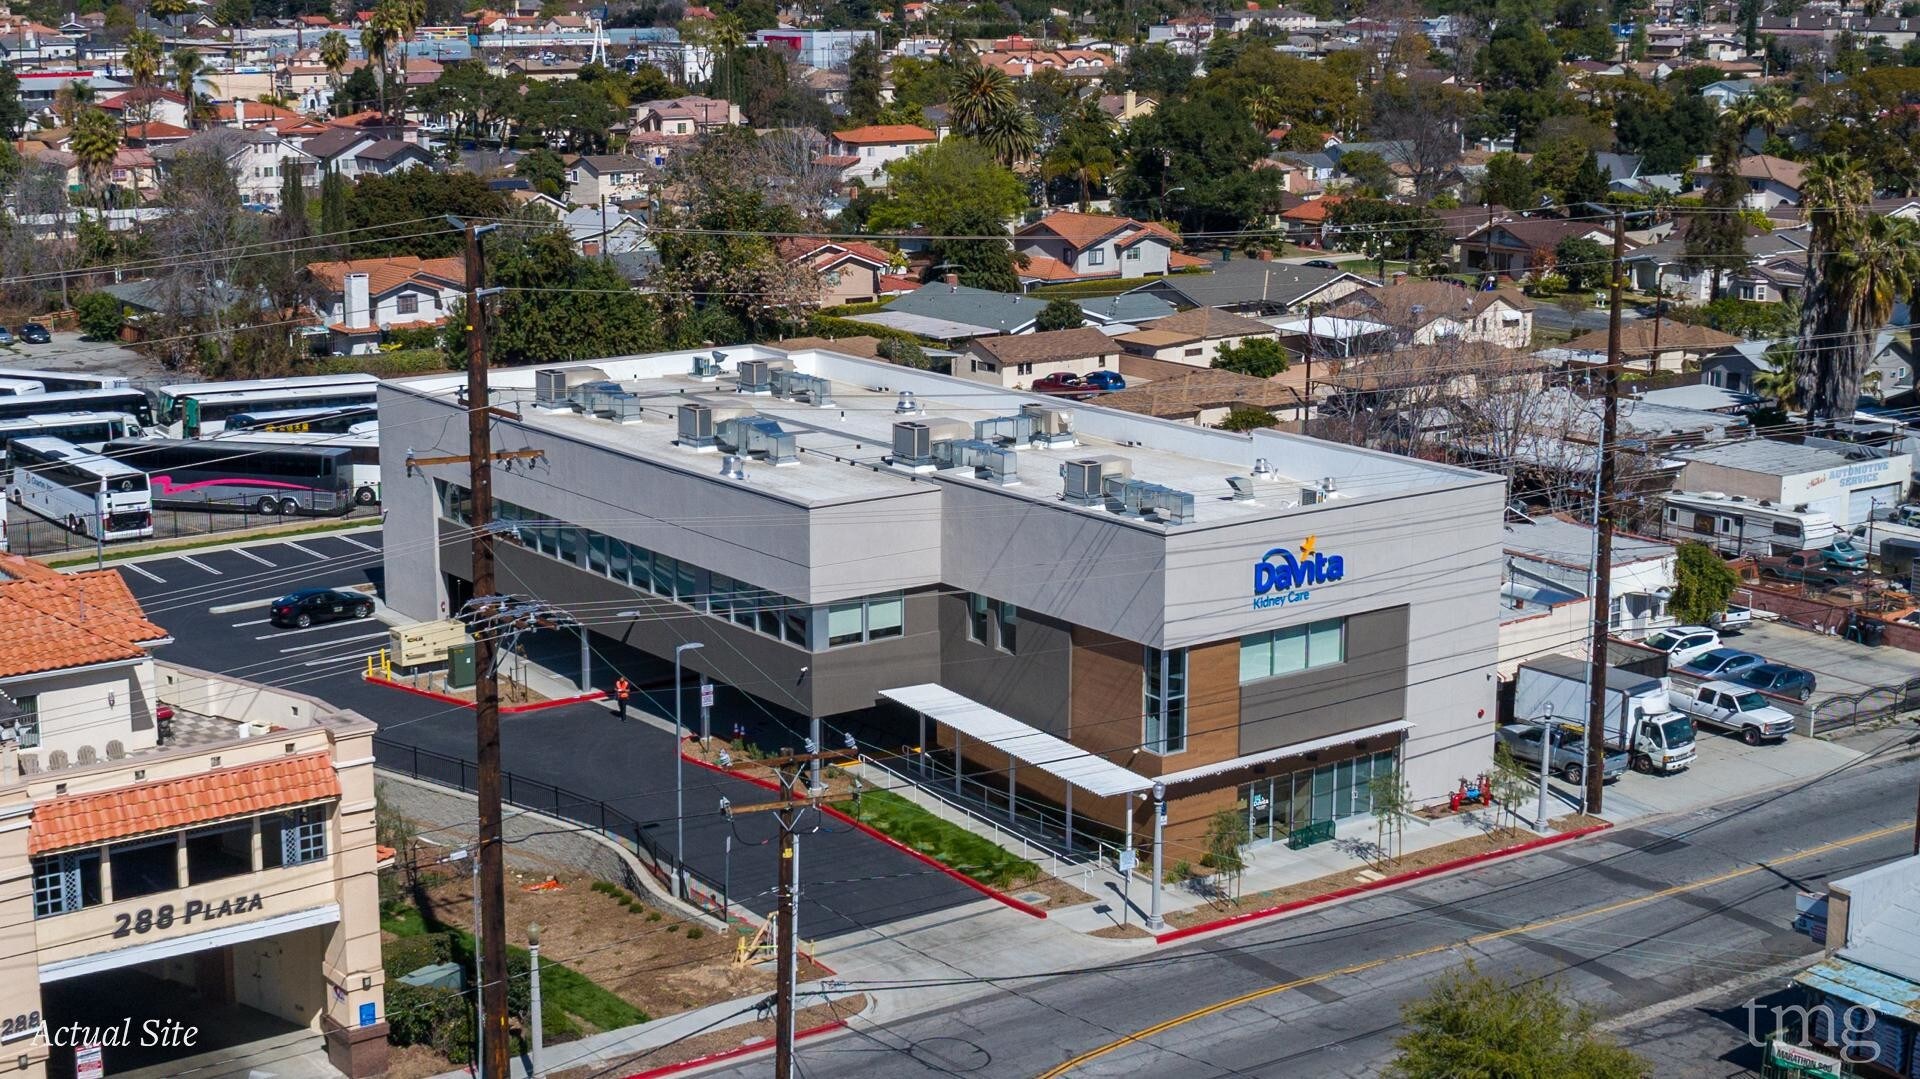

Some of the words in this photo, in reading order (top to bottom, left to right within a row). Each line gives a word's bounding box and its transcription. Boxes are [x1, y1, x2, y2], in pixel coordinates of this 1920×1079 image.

[1829, 460, 1889, 480] AUTOMOTIVE
[1840, 472, 1879, 487] SERVICE
[1254, 548, 1344, 596] DaVita
[1253, 596, 1286, 610] Kidney
[1287, 591, 1310, 603] Care
[113, 904, 174, 938] 288
[183, 893, 263, 924] PLAZA
[1, 1011, 40, 1035] 288
[1777, 1049, 1817, 1069] MARATHON
